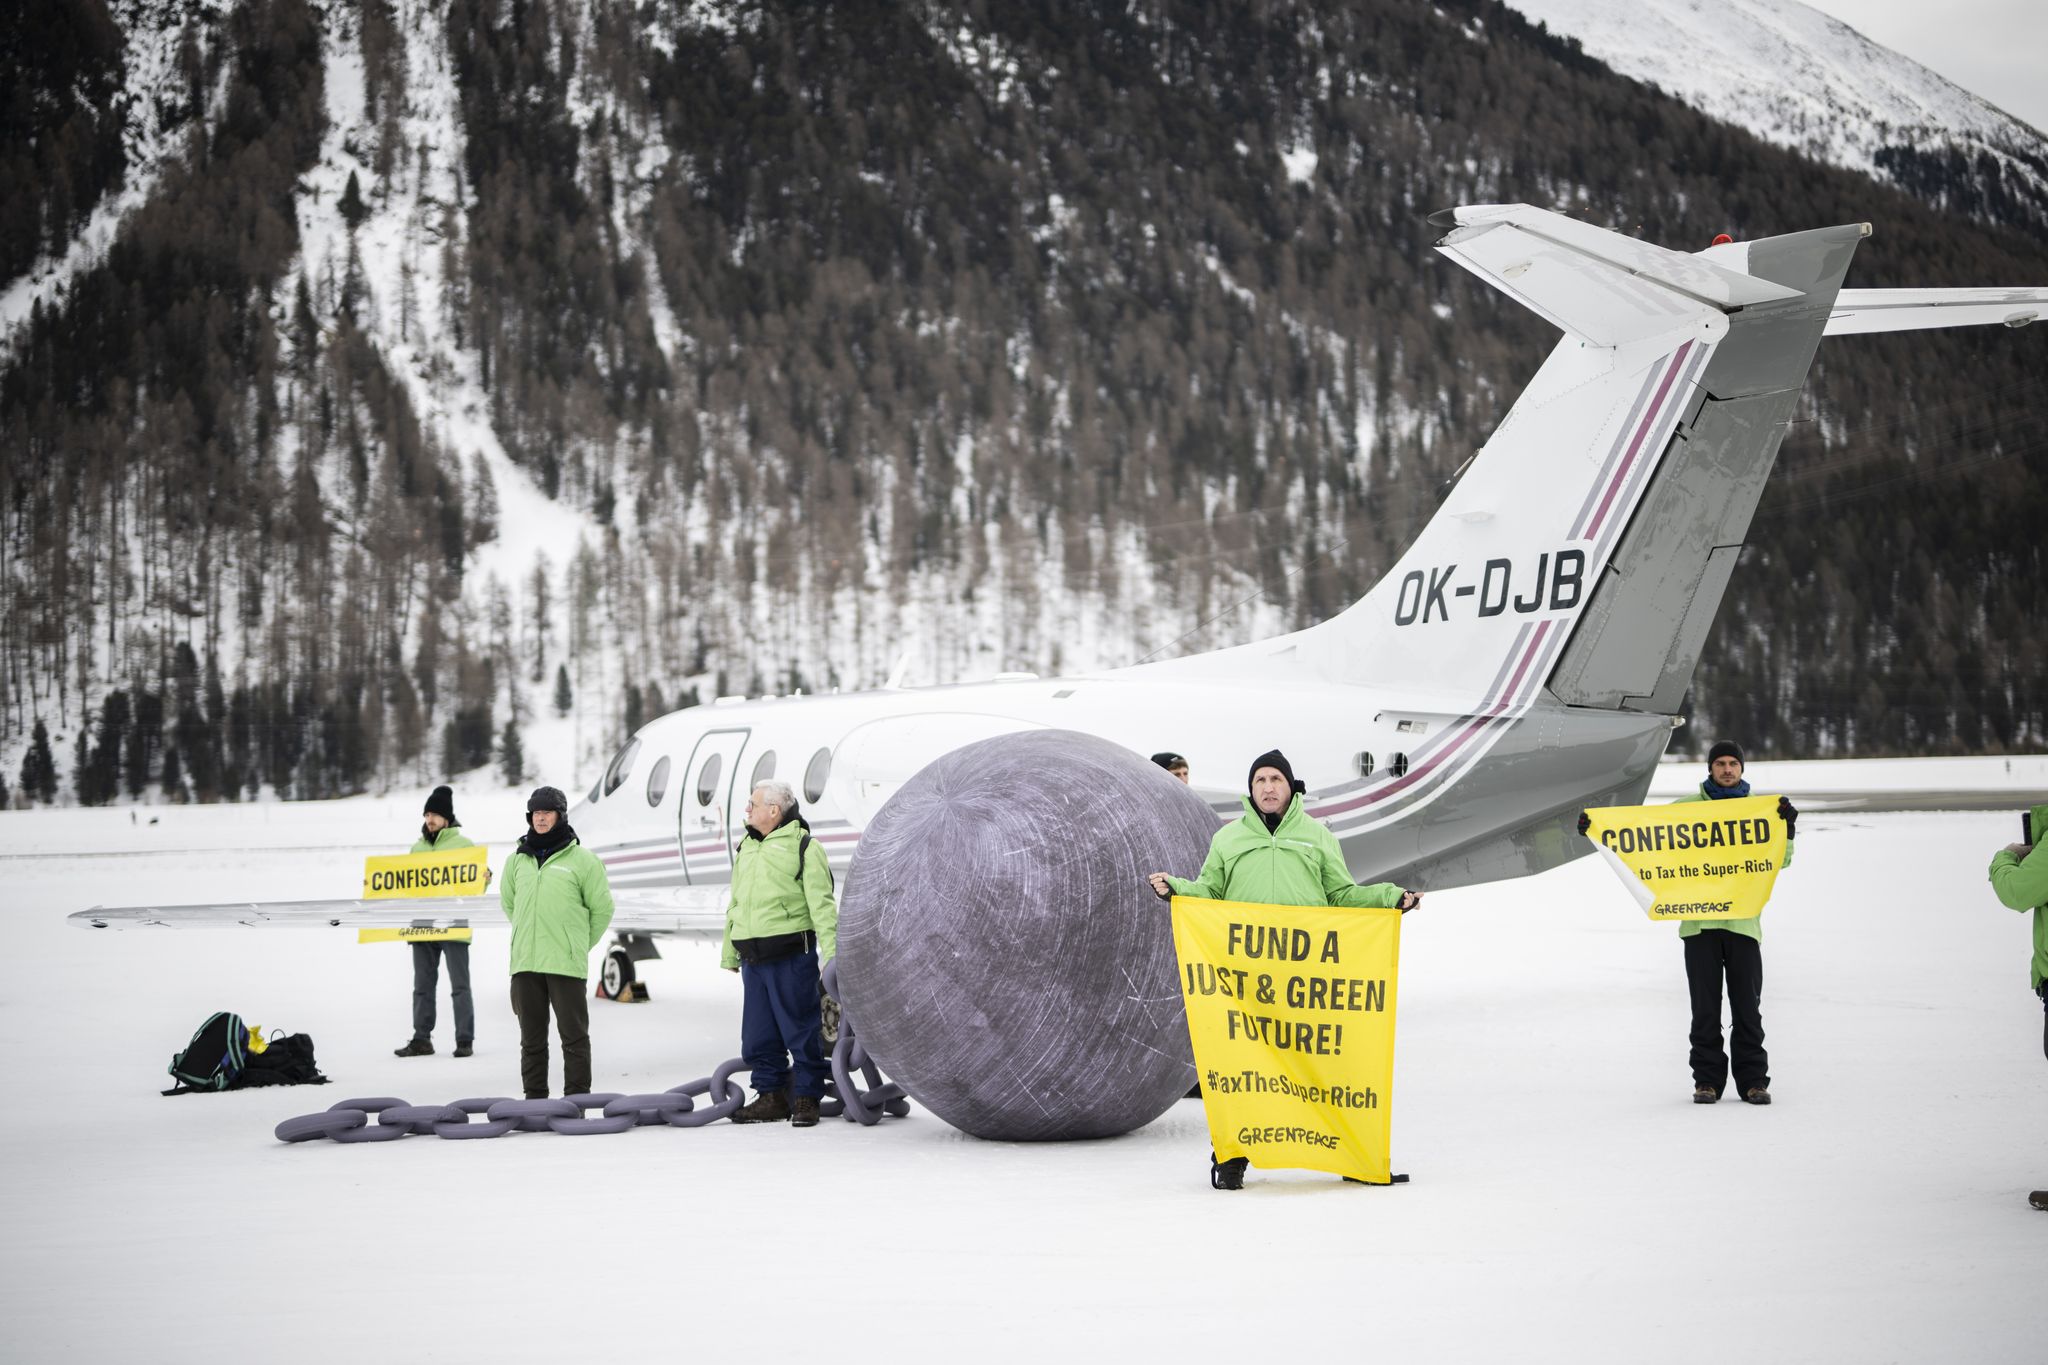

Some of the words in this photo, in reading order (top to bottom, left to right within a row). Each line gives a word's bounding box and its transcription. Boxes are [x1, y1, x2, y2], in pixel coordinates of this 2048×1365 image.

[1395, 549, 1585, 626] OK-DJB
[1602, 819, 1770, 853] CONFISCATED
[372, 864, 477, 890] CONFISCATED
[1640, 869, 1652, 880] to
[1656, 866, 1675, 879] Tax
[1679, 865, 1698, 877] the
[1703, 859, 1772, 877] Super-Rich
[1655, 901, 1733, 915] GREENPEACE
[1229, 923, 1310, 961] FUND
[1320, 931, 1339, 963] A
[1187, 964, 1248, 1000] JUST
[1256, 974, 1275, 1004] &
[1287, 976, 1386, 1012] GREEN
[1228, 1010, 1342, 1055] FUTURE!
[1238, 1127, 1340, 1149] GREENPEACE
